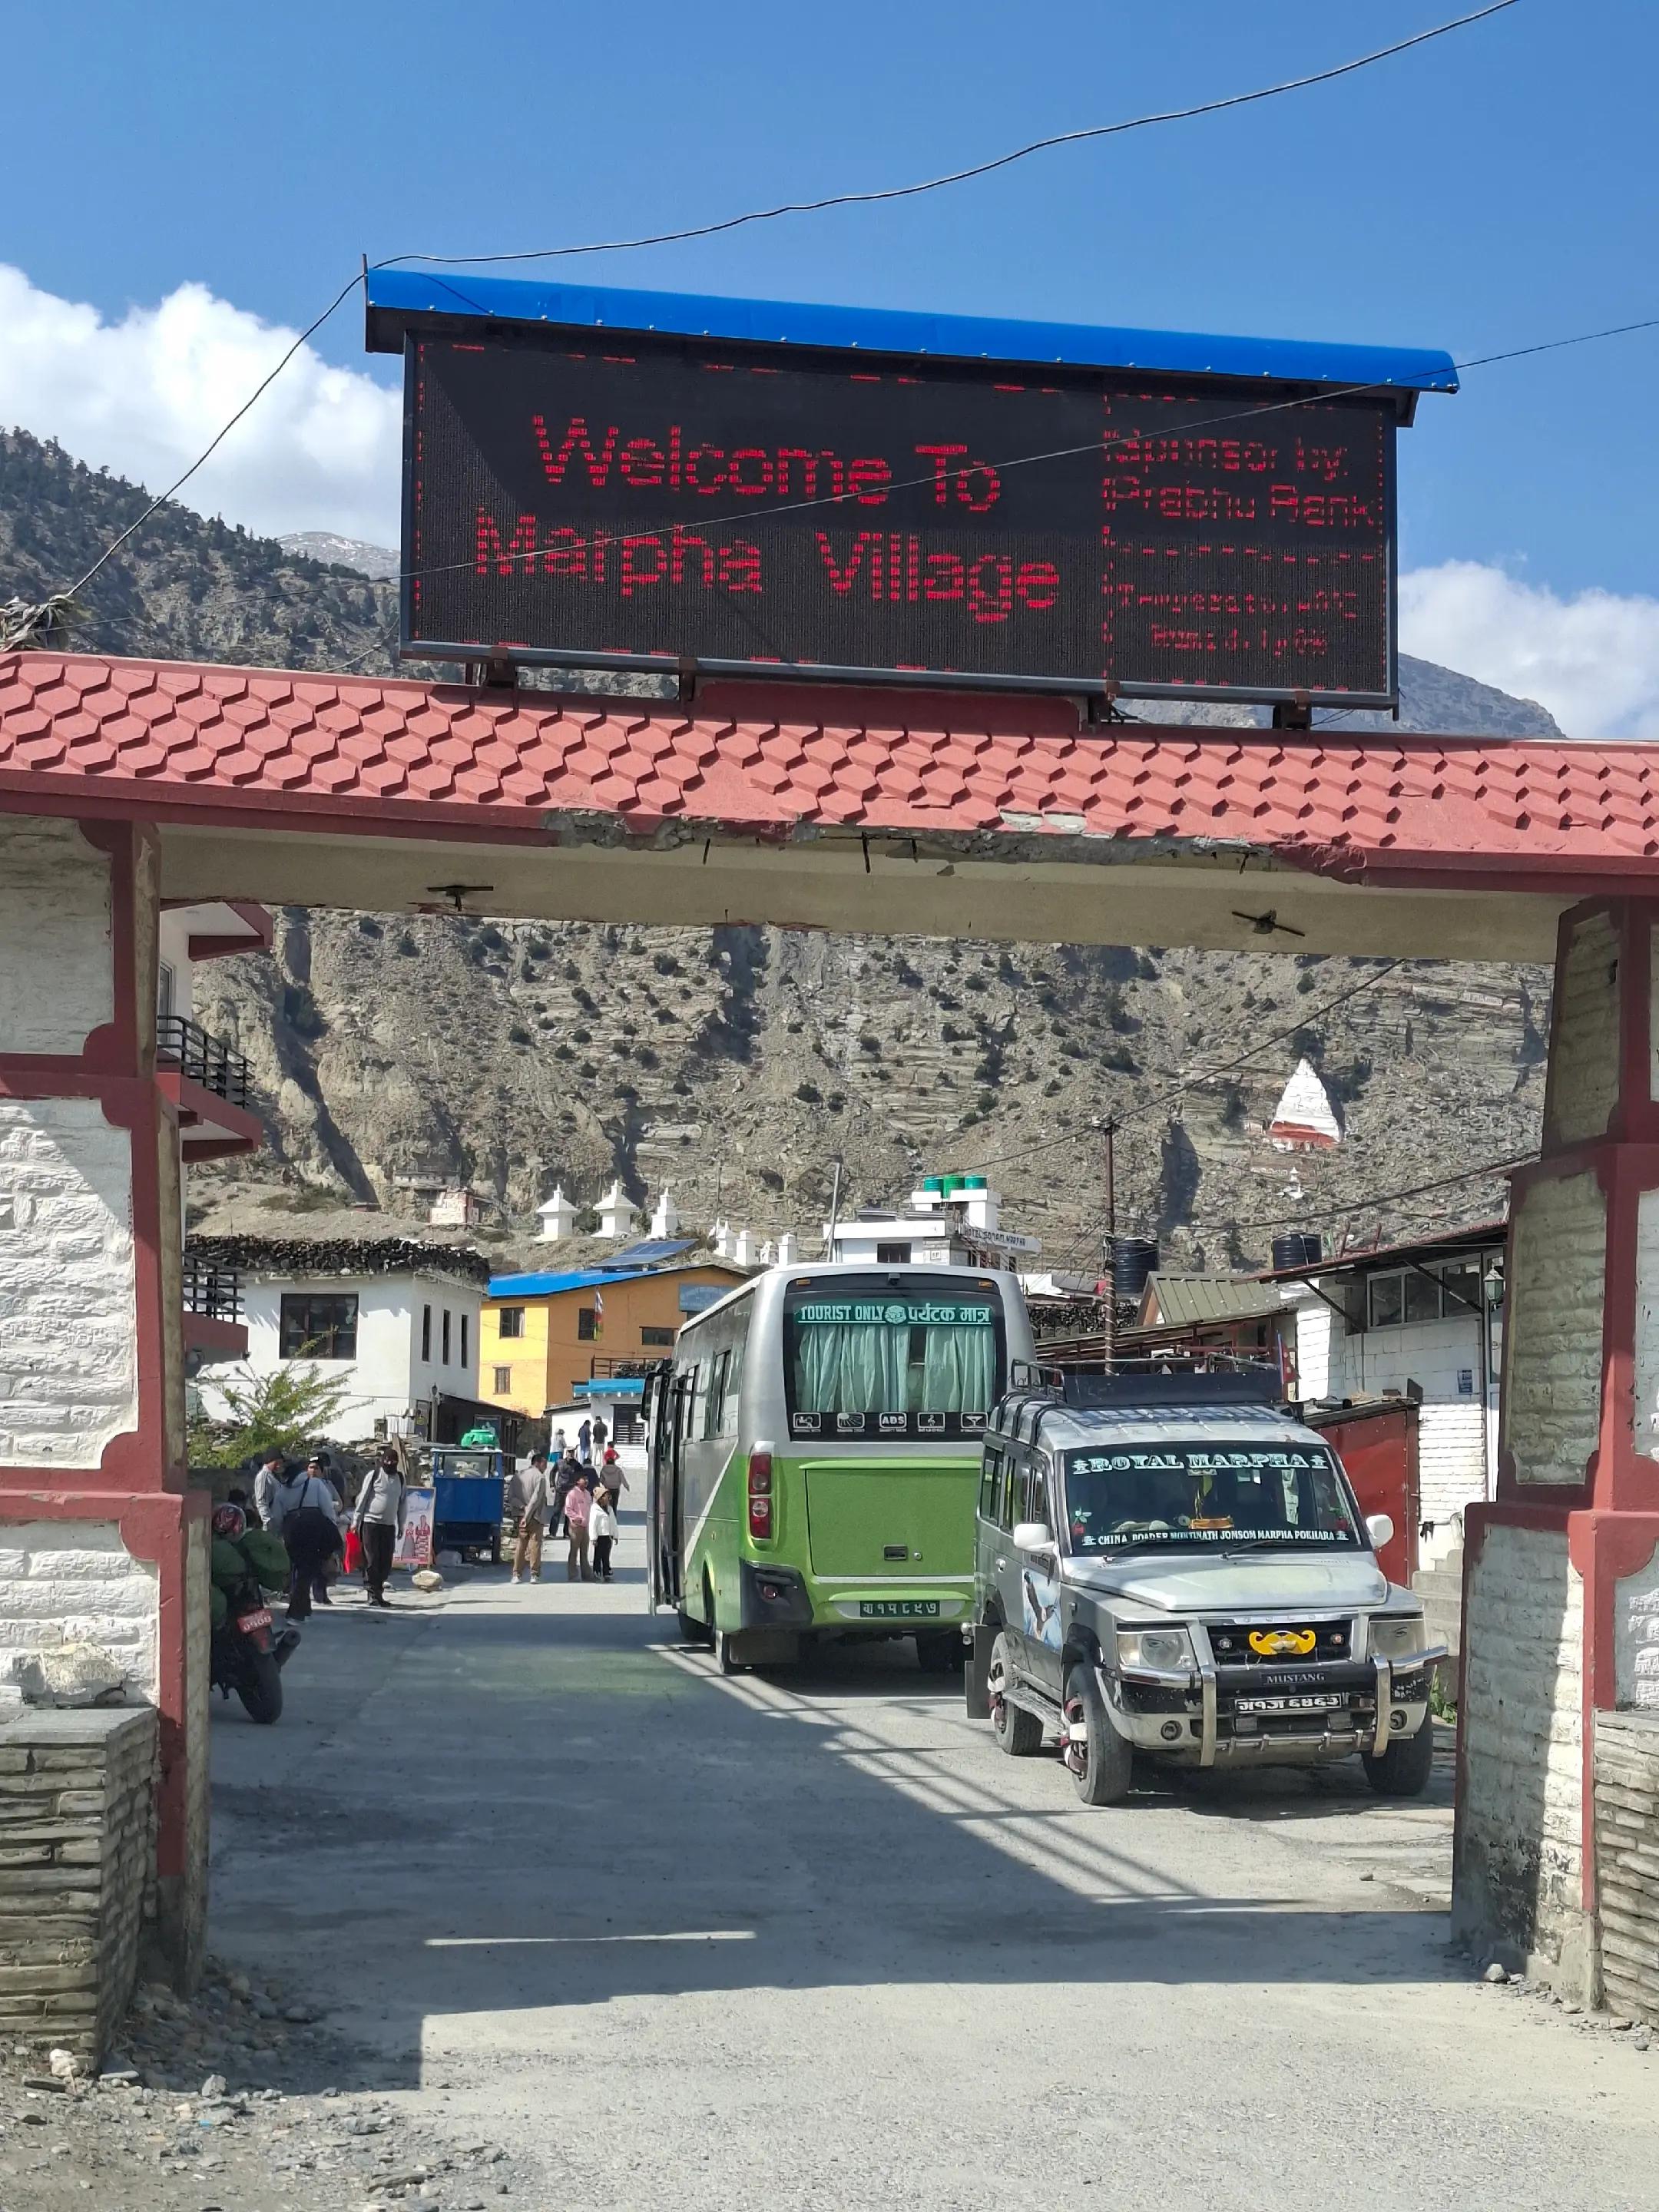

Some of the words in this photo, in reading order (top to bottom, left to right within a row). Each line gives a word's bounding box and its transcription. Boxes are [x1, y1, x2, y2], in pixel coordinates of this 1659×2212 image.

[531, 415, 892, 505] Welcome
[915, 444, 1002, 512] To
[475, 507, 763, 598] Marpha
[815, 531, 1061, 624] Village
[801, 1306, 851, 1320] TOURIST
[855, 1306, 884, 1320] ONLY
[908, 1303, 955, 1322] पर्यटक
[960, 1308, 990, 1323] मात्र
[1088, 1455, 1184, 1472] ROYAL
[1186, 1453, 1310, 1469] MARPHA
[1098, 1535, 1128, 1545] CHINA
[1220, 1531, 1257, 1540] JOMSOM
[1257, 1531, 1293, 1540] MARPHA
[1294, 1531, 1335, 1541] POKHARA
[1267, 1673, 1325, 1684] MUSTANG
